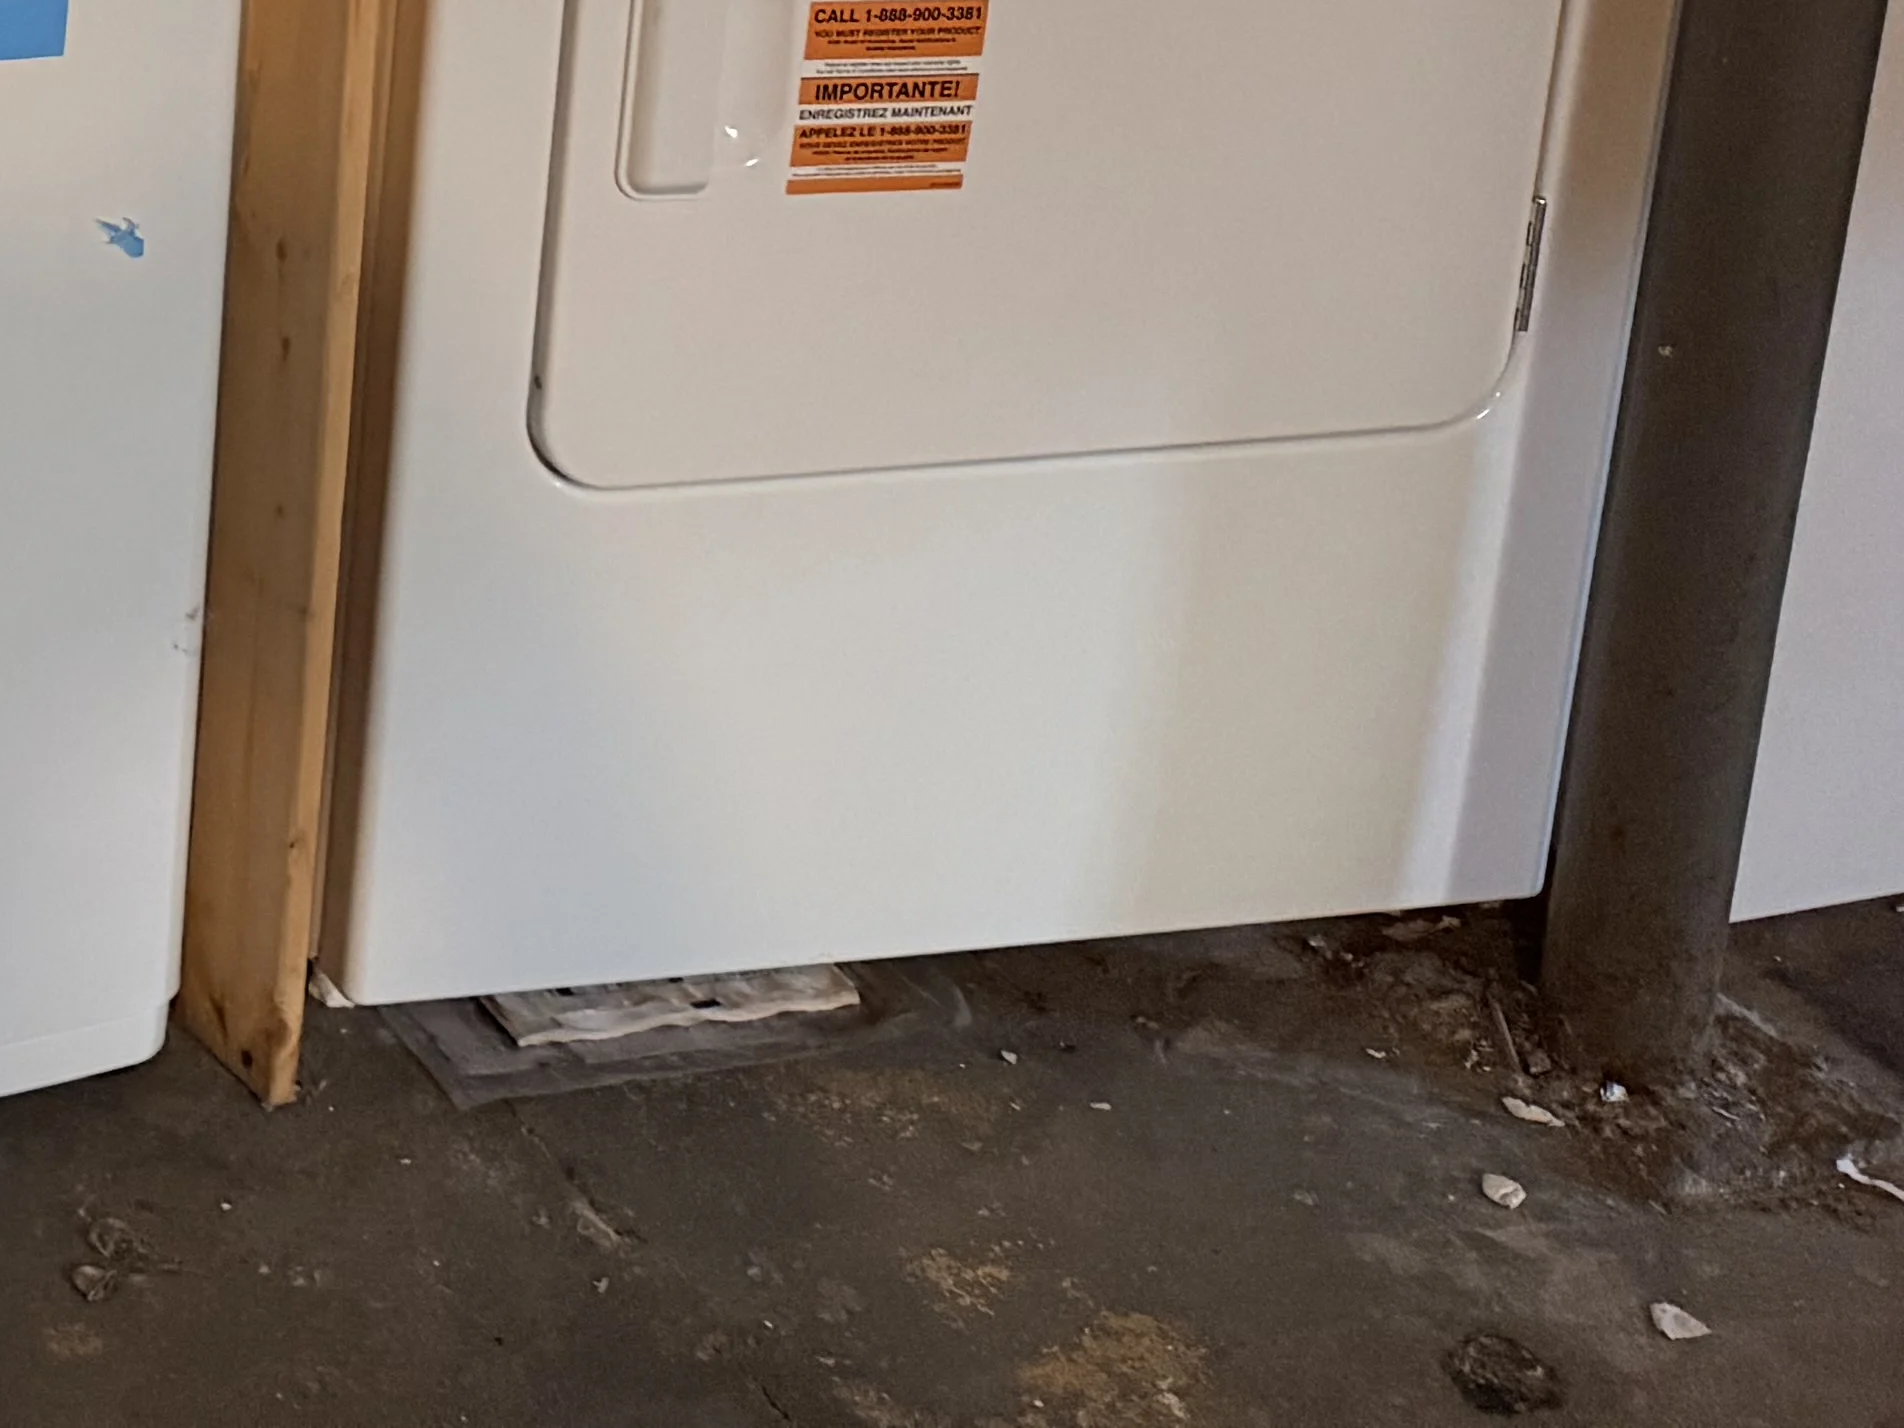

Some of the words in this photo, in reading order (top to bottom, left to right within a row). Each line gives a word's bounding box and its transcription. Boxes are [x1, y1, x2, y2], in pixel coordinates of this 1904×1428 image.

[814, 8, 860, 24] CALL
[836, 29, 861, 38] MUST
[863, 28, 910, 37] REGISTER
[937, 26, 982, 36] PRODUCT
[815, 80, 961, 102] IMPORTANTE!
[799, 107, 889, 121] ENREGISTREZ
[891, 104, 973, 119] MAINTENANT
[799, 126, 857, 139] APPELEZ
[859, 125, 878, 137] LE
